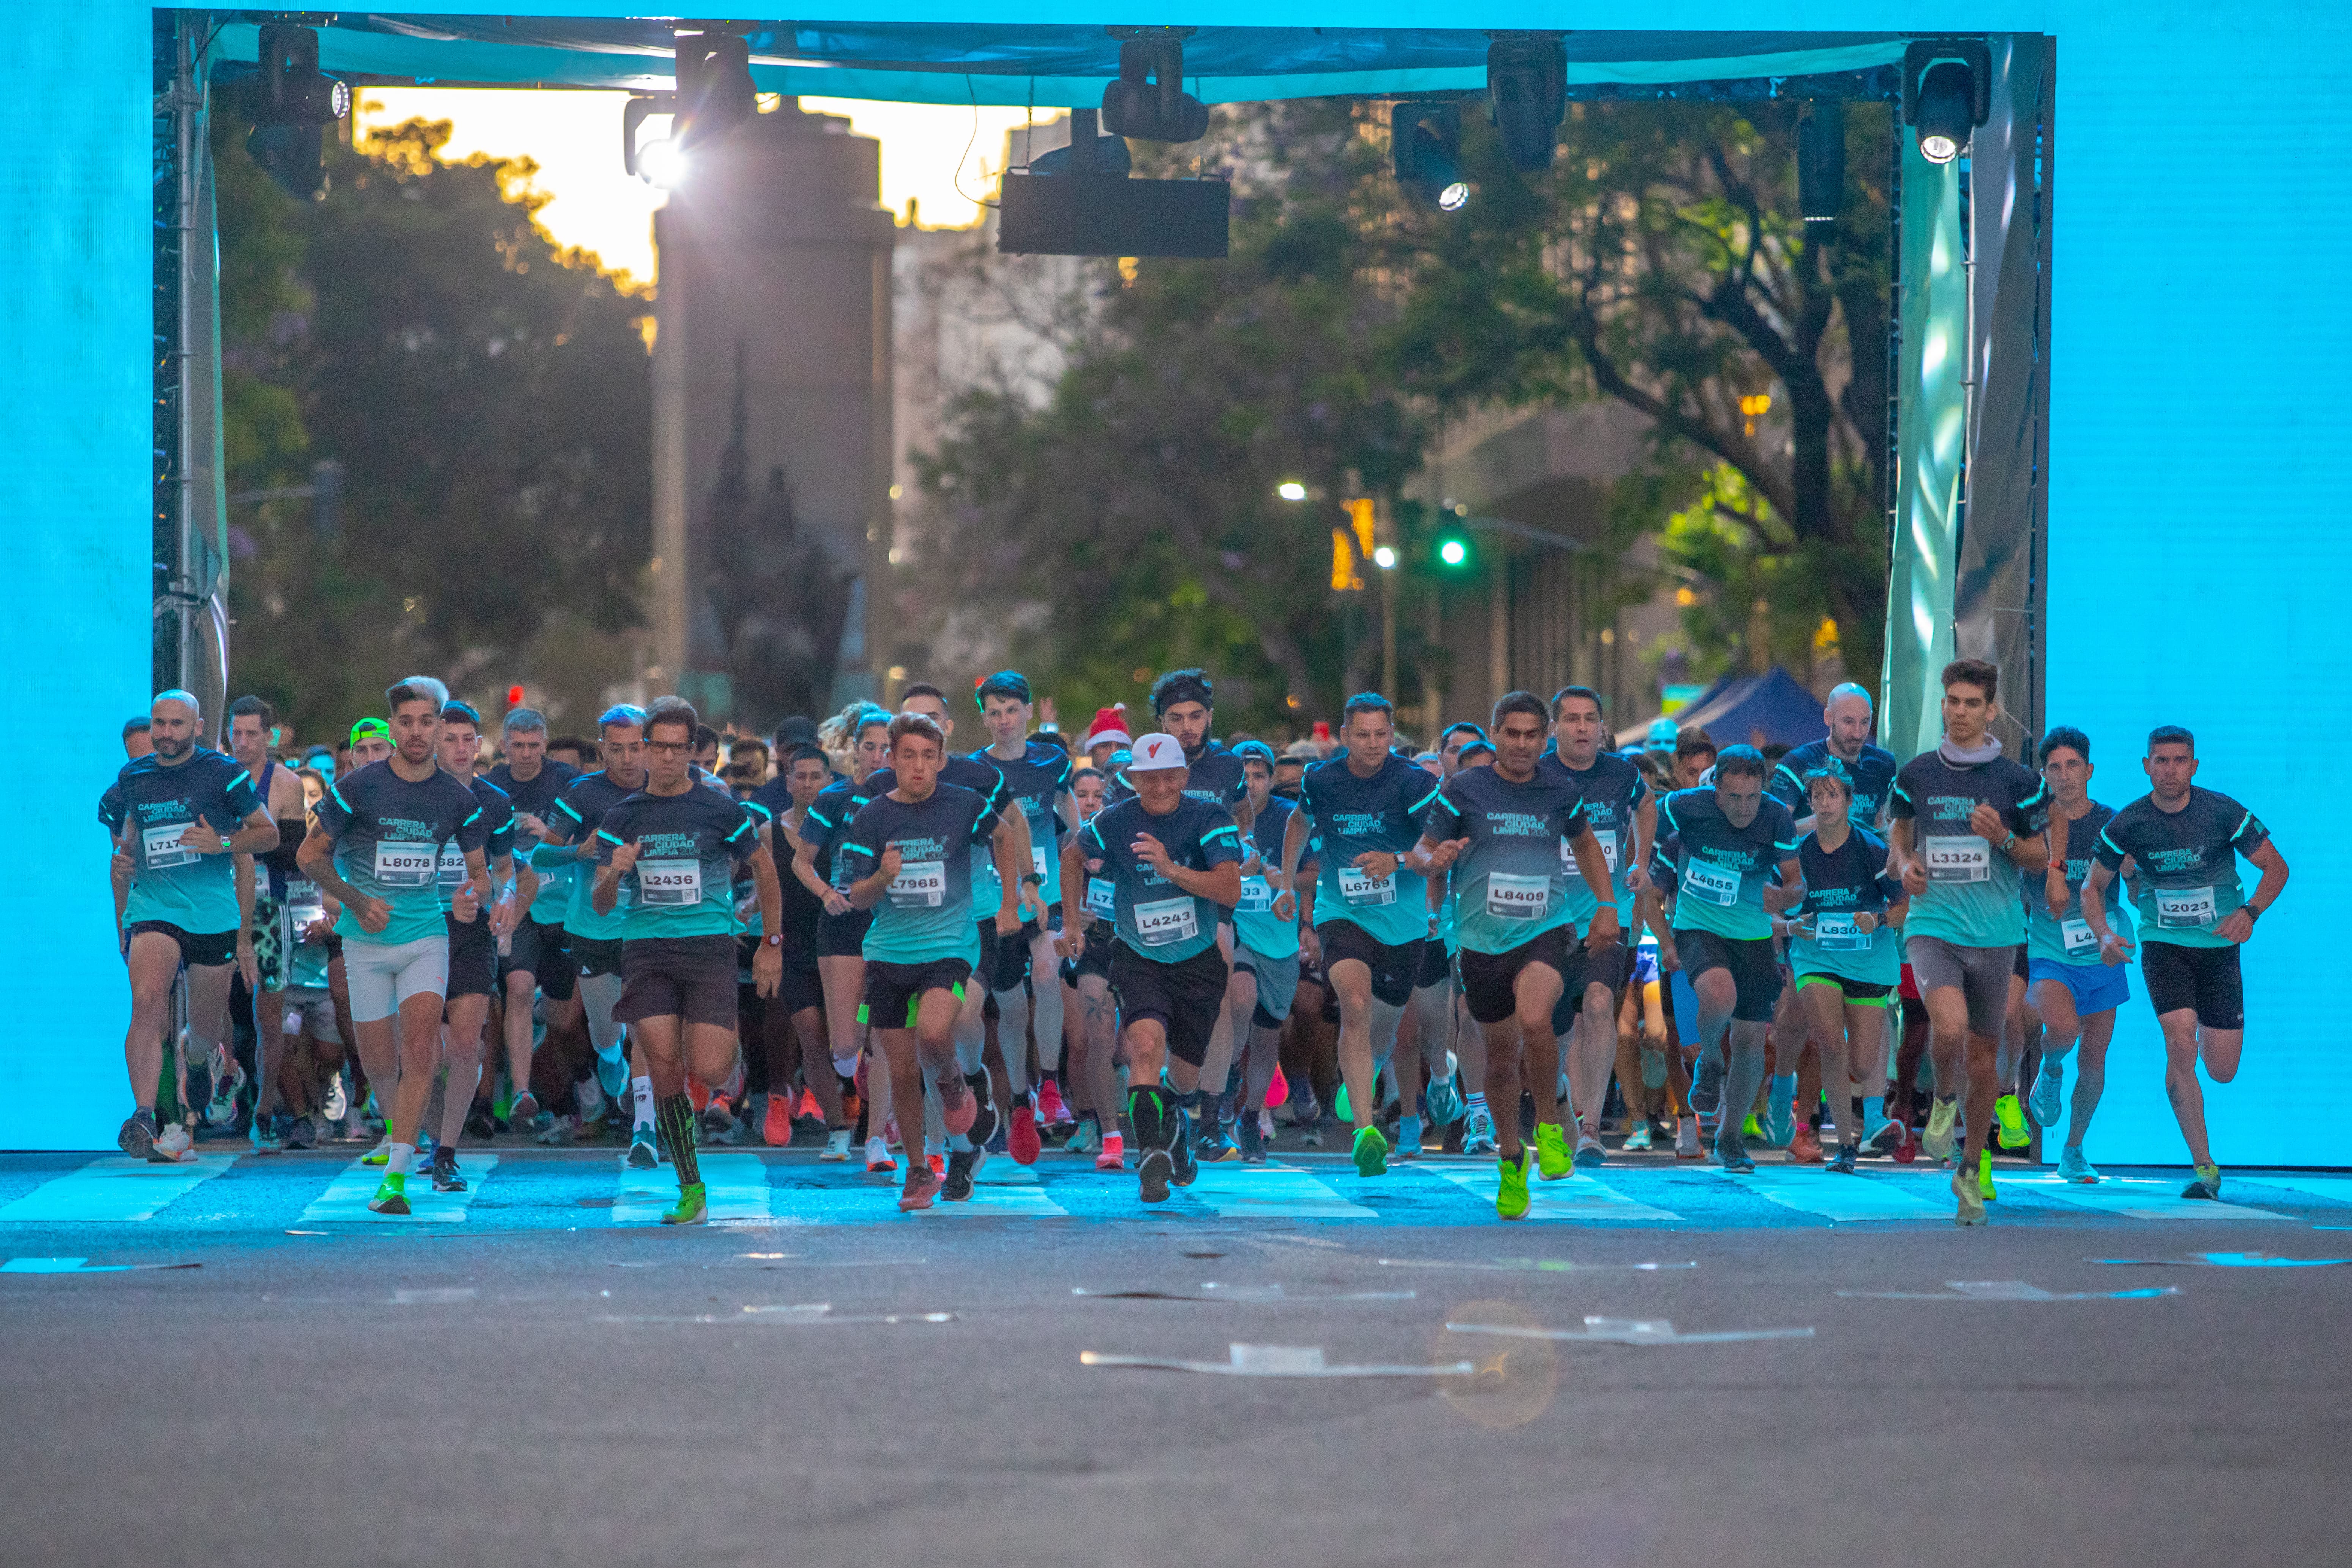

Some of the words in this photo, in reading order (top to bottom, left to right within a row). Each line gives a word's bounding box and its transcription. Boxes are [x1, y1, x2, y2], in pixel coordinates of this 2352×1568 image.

[1944, 803, 1975, 813] CIUDA
[1333, 813, 1373, 821] CARRERA
[1487, 812, 1537, 822] CARRERA
[378, 817, 426, 830] CARRERA
[1348, 819, 1381, 829] CIUDAD
[1504, 820, 1545, 829] CIUDAD
[396, 826, 432, 838] CIUDAD
[1493, 826, 1526, 835] LIMPIA
[637, 833, 687, 843] CARRERA
[150, 839, 180, 851] L717
[654, 840, 695, 849] CIUDAD
[1932, 853, 1983, 863] L3324
[2148, 848, 2193, 860] CARRERA
[383, 857, 430, 867] L8078
[2164, 854, 2201, 865] CIUDAD
[645, 875, 693, 886] L2436
[1691, 871, 1733, 890] L4855
[1242, 887, 1260, 896] 33
[1494, 889, 1544, 901] L8409
[1809, 887, 1850, 898] CARRERA
[1823, 894, 1857, 902] CIUDAD
[2163, 901, 2209, 912] L2023
[1142, 911, 1190, 928] L4243
[1822, 926, 1862, 934] L830
